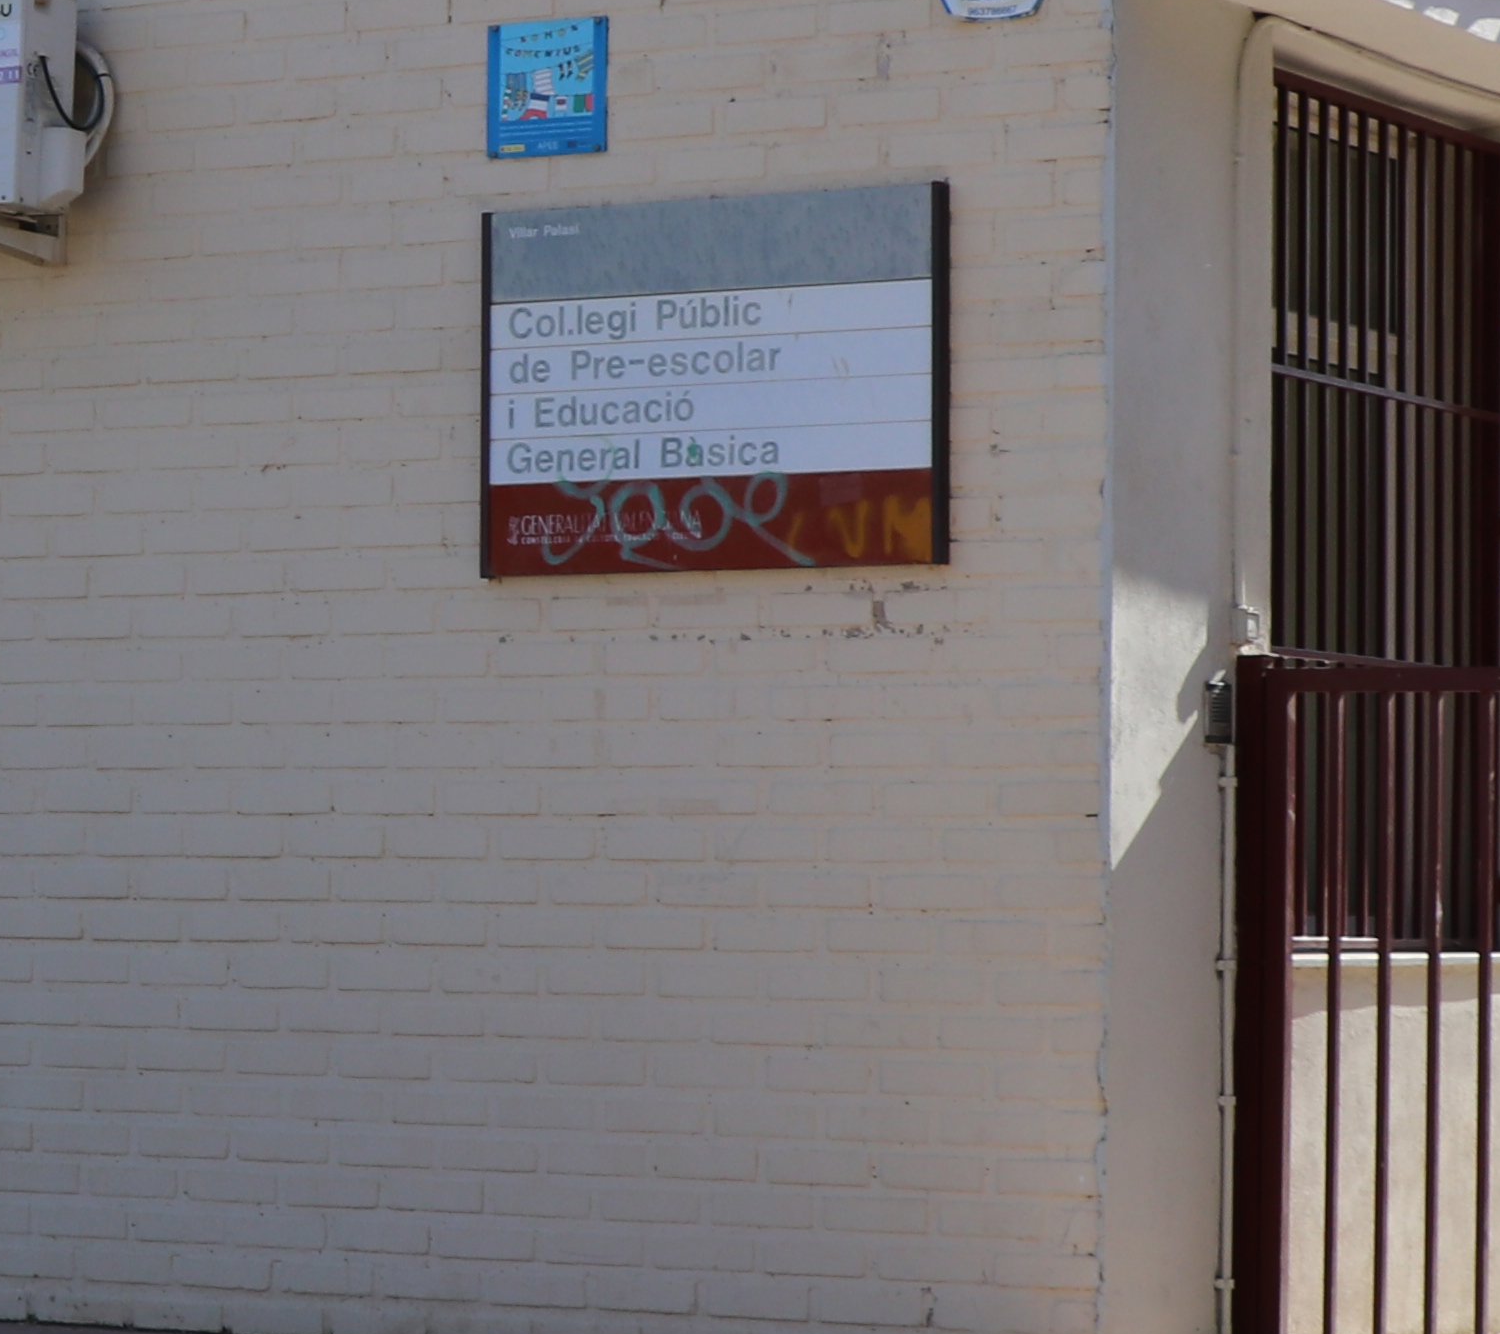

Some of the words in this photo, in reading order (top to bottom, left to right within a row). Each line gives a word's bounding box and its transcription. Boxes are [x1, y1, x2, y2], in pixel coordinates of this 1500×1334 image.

[508, 302, 637, 341] Col.legi
[656, 295, 762, 331] Públic
[508, 353, 551, 384] de
[570, 342, 782, 381] Pre-escolar
[508, 399, 515, 430] i
[534, 390, 694, 429] Educació
[507, 440, 641, 473] General
[660, 436, 780, 468] Bàsica
